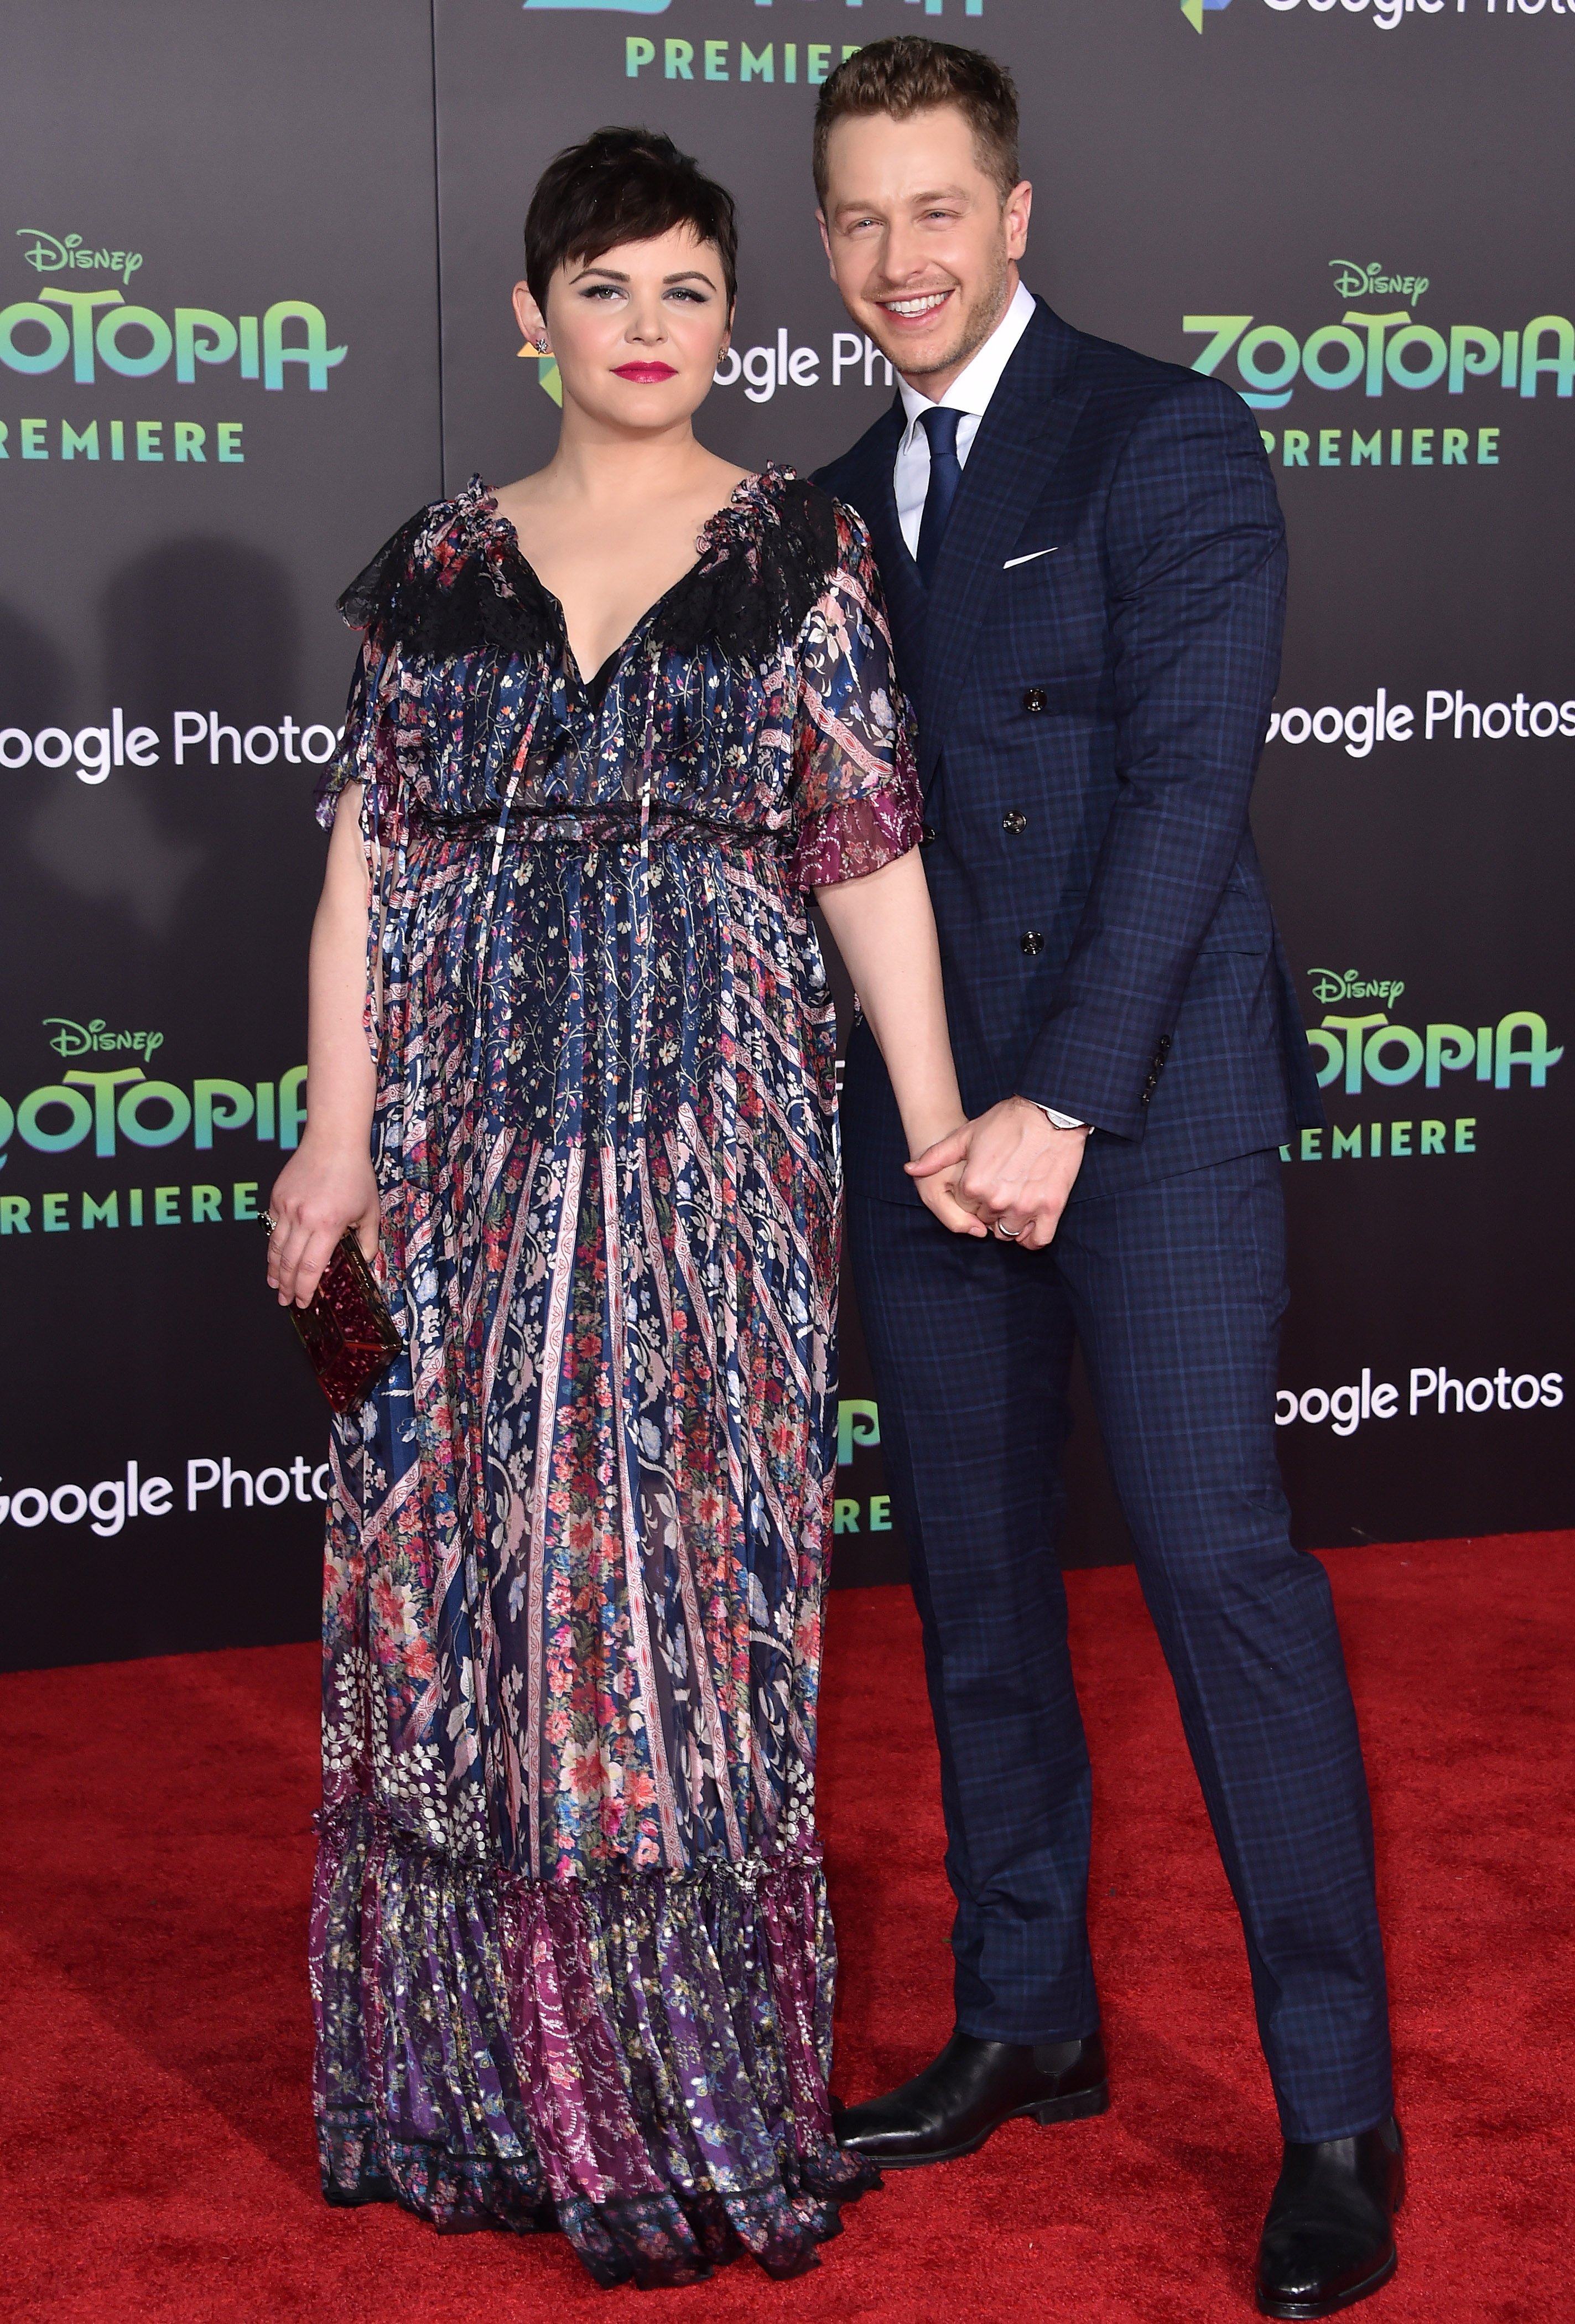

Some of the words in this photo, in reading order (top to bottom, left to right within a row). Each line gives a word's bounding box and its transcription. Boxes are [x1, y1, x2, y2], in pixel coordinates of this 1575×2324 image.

[174, 711, 346, 765] Photo
[1265, 688, 1415, 758] oogle
[0, 1065, 308, 1170] OTOPI
[1410, 1367, 1564, 1416] Photos
[0, 1460, 174, 1537] oogle
